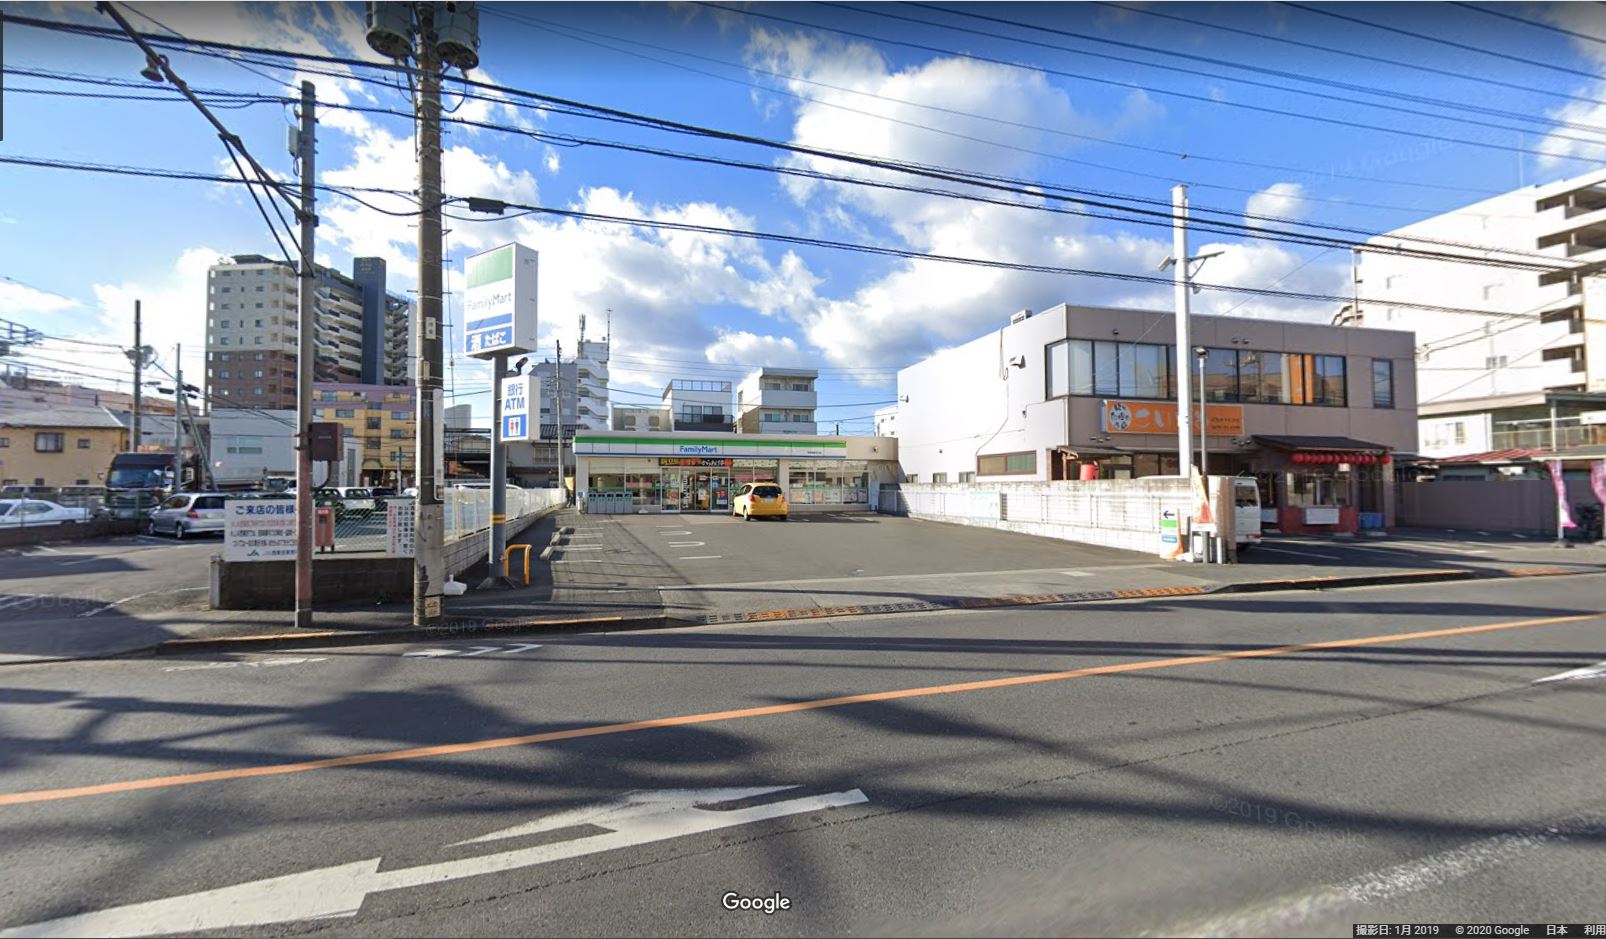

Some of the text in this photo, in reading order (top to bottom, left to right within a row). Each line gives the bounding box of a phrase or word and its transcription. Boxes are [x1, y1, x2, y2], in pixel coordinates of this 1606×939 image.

[467, 292, 512, 310] FamilyMart
[507, 383, 524, 396] 銀行
[505, 397, 525, 410] ATM
[679, 445, 718, 454] FamilyMart
